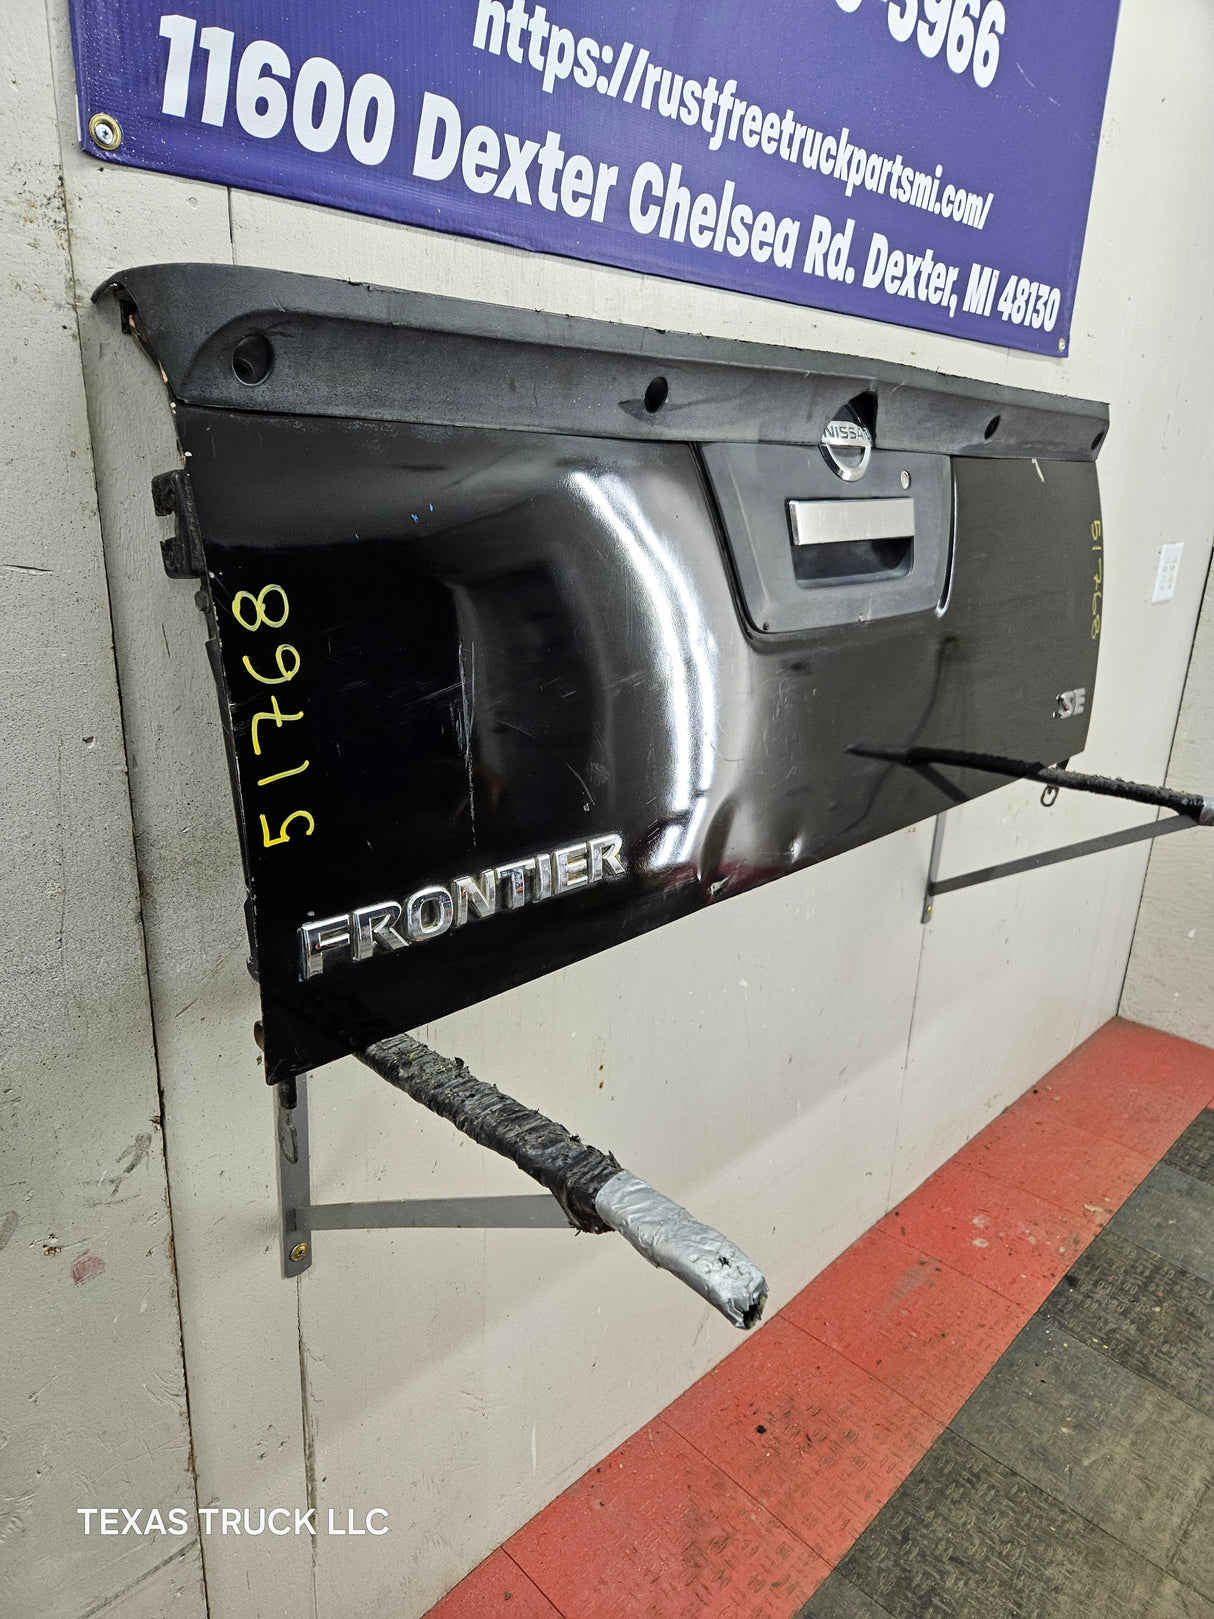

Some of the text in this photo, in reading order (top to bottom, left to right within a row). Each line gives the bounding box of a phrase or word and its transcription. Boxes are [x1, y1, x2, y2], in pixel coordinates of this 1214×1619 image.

[158, 14, 1062, 332] 11600 Dexter Chelsea Rd. Dexter, MI 48130
[823, 424, 873, 442] NISSAN
[231, 583, 315, 848] 51768
[1052, 687, 1086, 720] SE
[298, 833, 626, 983] FRONTIER
